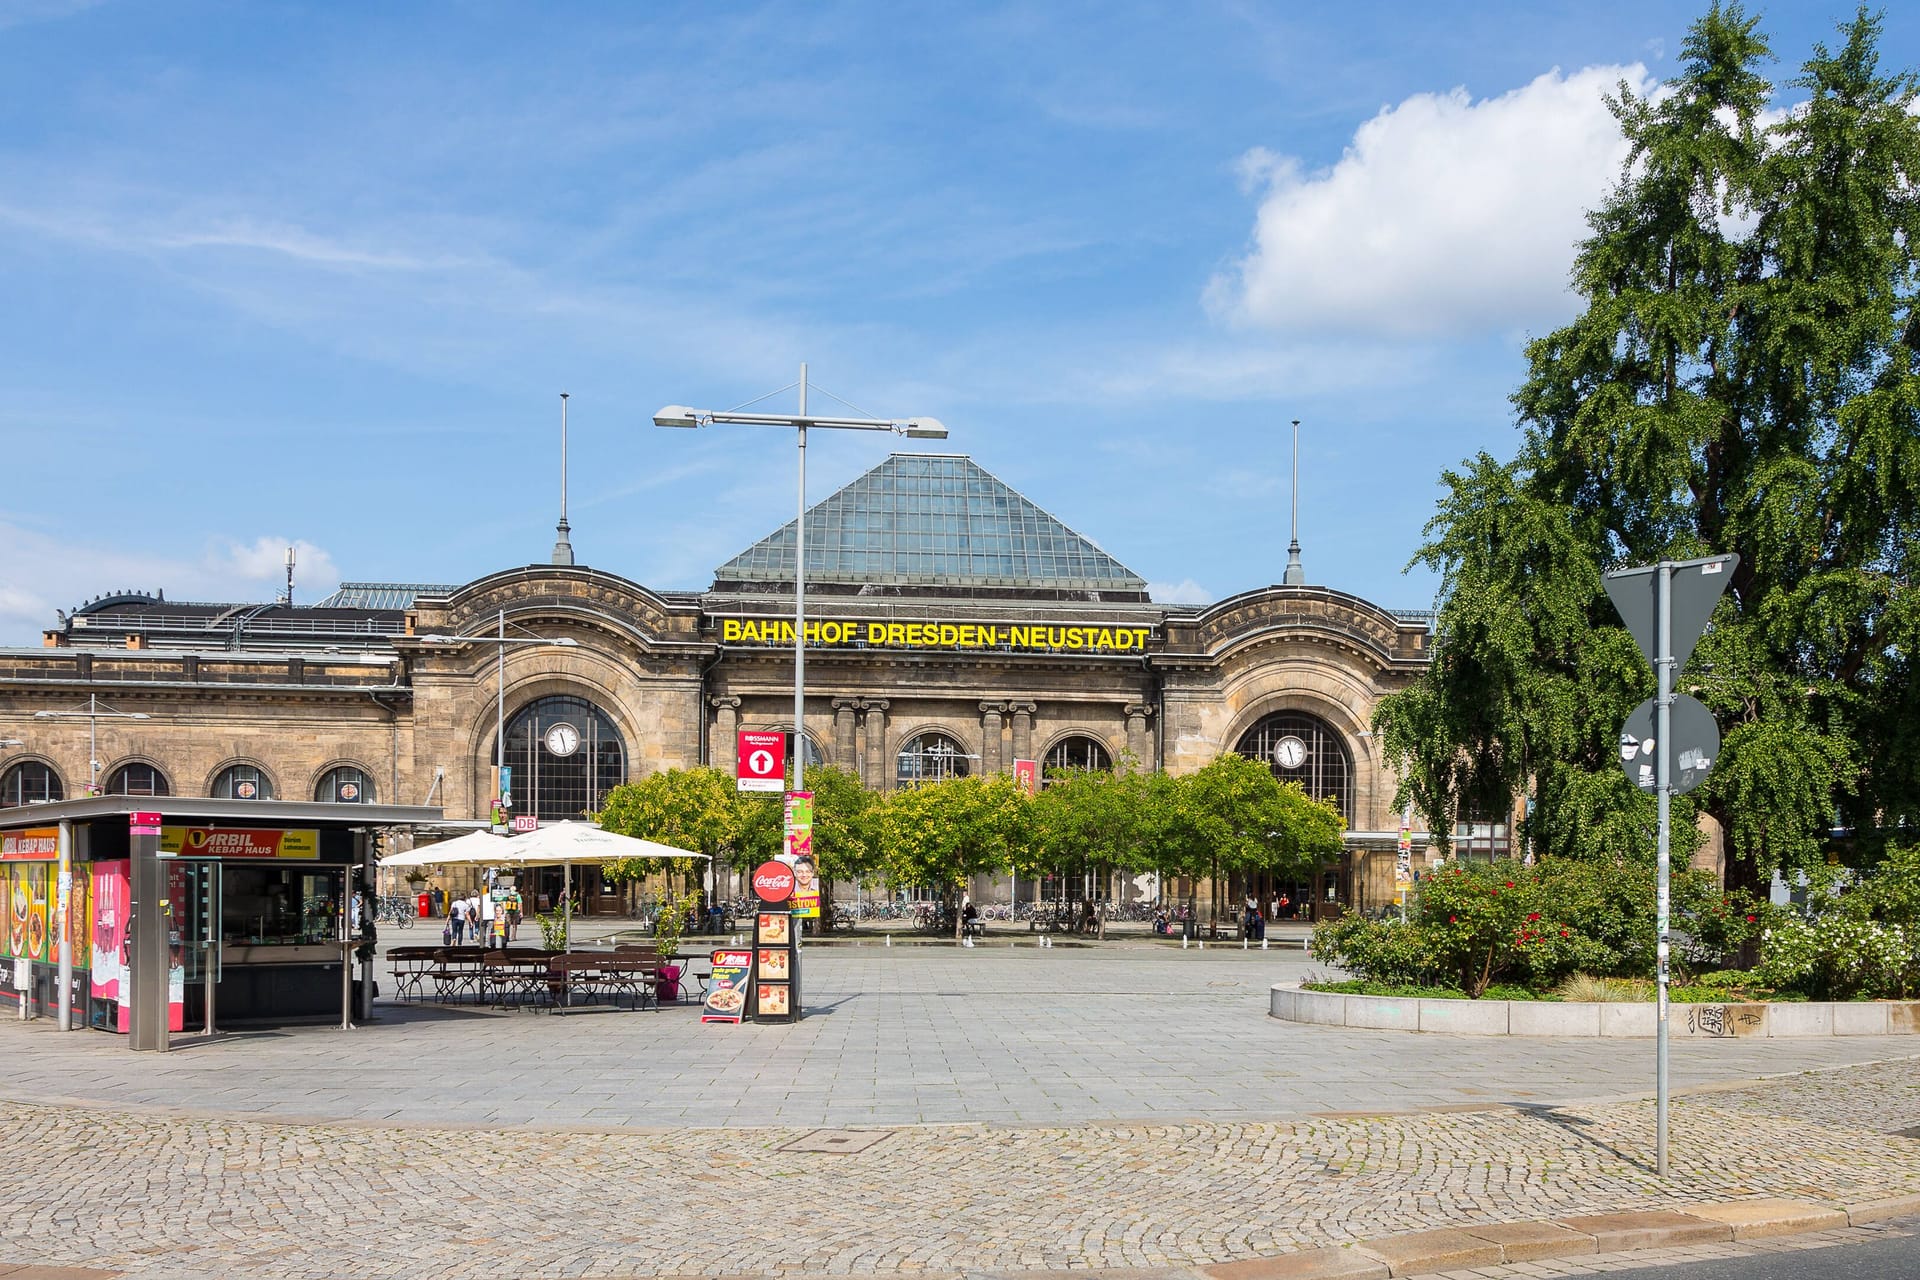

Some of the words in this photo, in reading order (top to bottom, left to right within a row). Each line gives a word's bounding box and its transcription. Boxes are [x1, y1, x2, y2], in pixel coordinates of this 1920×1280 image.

[723, 619, 858, 643] BAHNHOF
[868, 622, 1149, 649] DRESDEN-NEUSTADT
[518, 819, 535, 829] DB
[203, 833, 254, 847] ARBIL
[208, 845, 242, 854] KEBAP
[245, 846, 272, 854] HAUS
[755, 874, 792, 888] Coca-Cola
